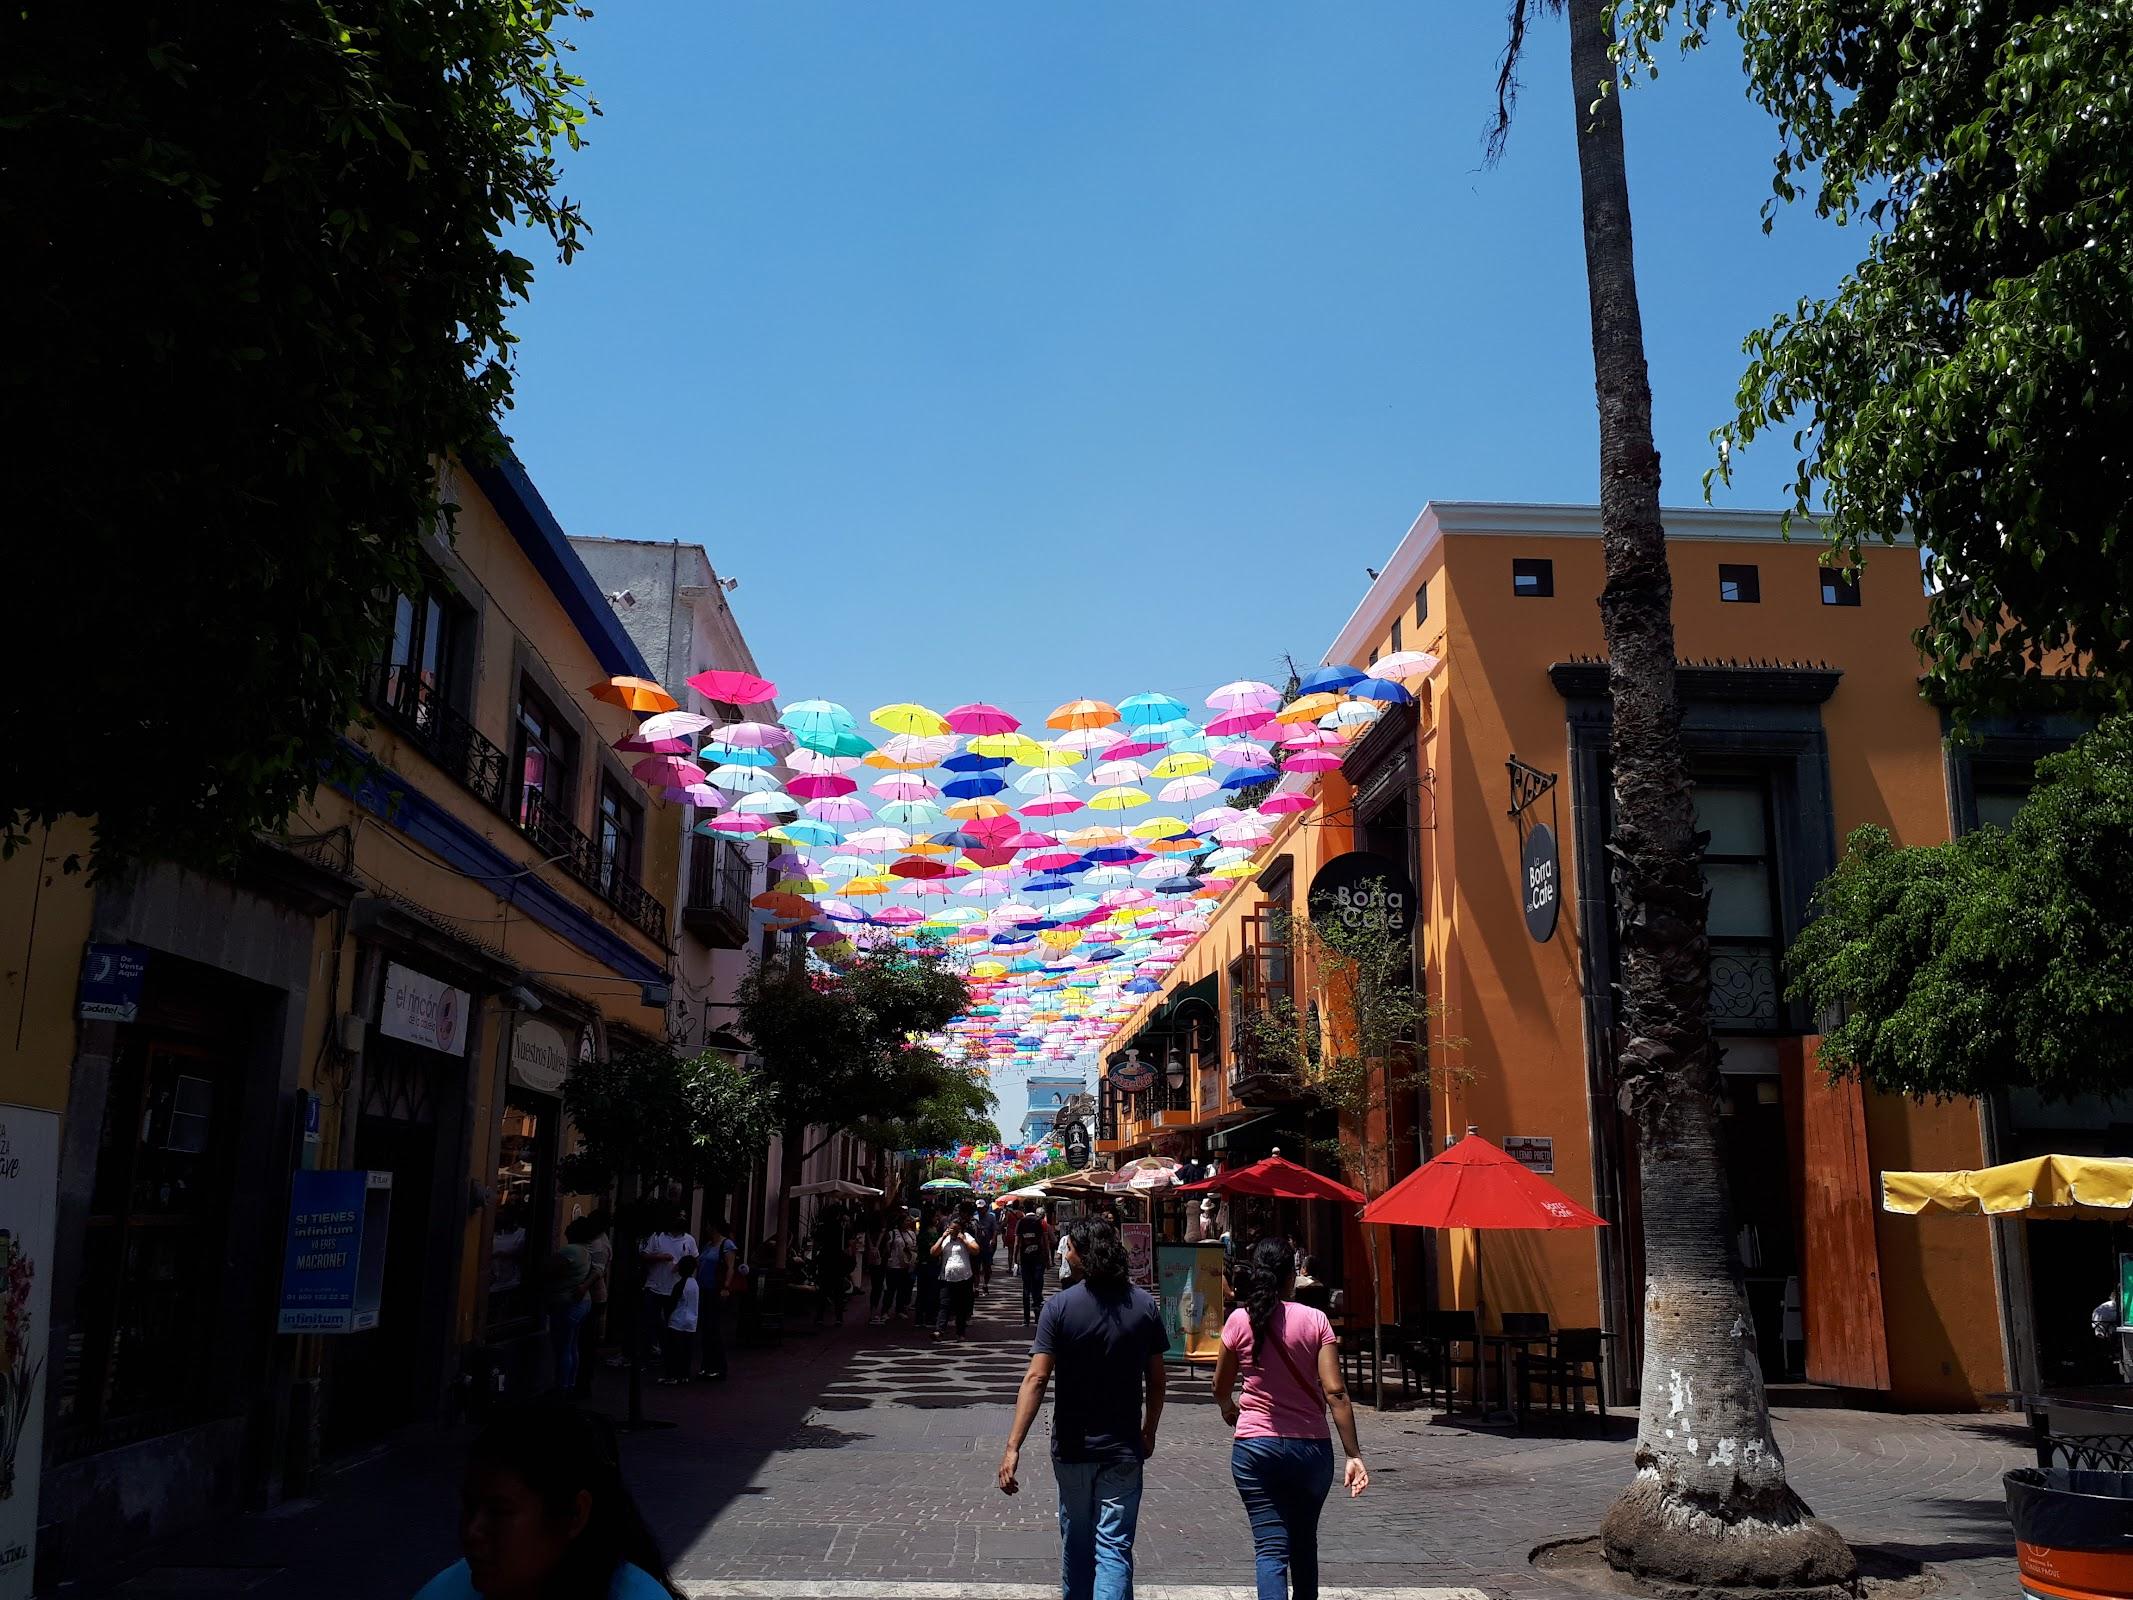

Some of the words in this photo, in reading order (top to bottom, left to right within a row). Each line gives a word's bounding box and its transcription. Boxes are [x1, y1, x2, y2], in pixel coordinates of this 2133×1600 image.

[1529, 859, 1552, 889] Borra
[1353, 879, 1368, 890] La
[119, 962, 145, 971] Venta
[396, 983, 408, 1010] el
[513, 1032, 547, 1067] Nuestros
[295, 1214, 308, 1225] SI
[310, 1211, 356, 1223] TIENES
[295, 1225, 354, 1237] infinitum
[296, 1252, 348, 1271] MACRONET
[283, 1312, 344, 1324] infinitum
